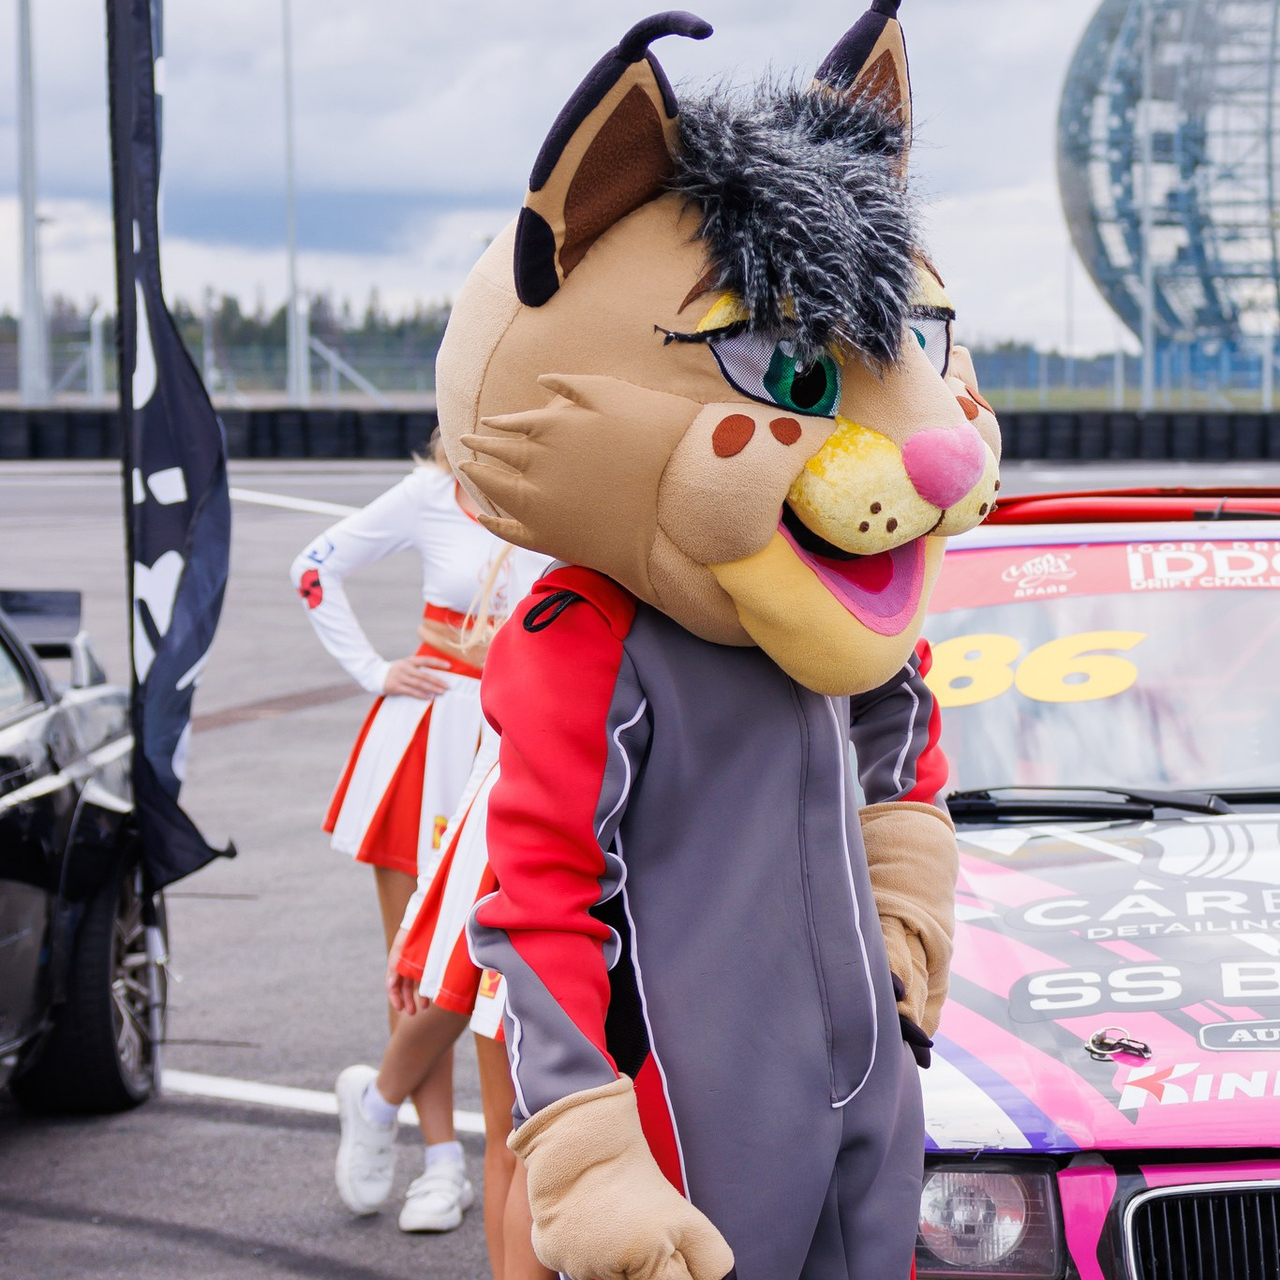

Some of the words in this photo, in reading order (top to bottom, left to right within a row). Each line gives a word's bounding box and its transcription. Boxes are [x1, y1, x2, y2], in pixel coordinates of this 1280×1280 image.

[1126, 542, 1217, 554] IGORA
[1130, 577, 1194, 590] DRIFT
[1027, 965, 1183, 1011] SS
